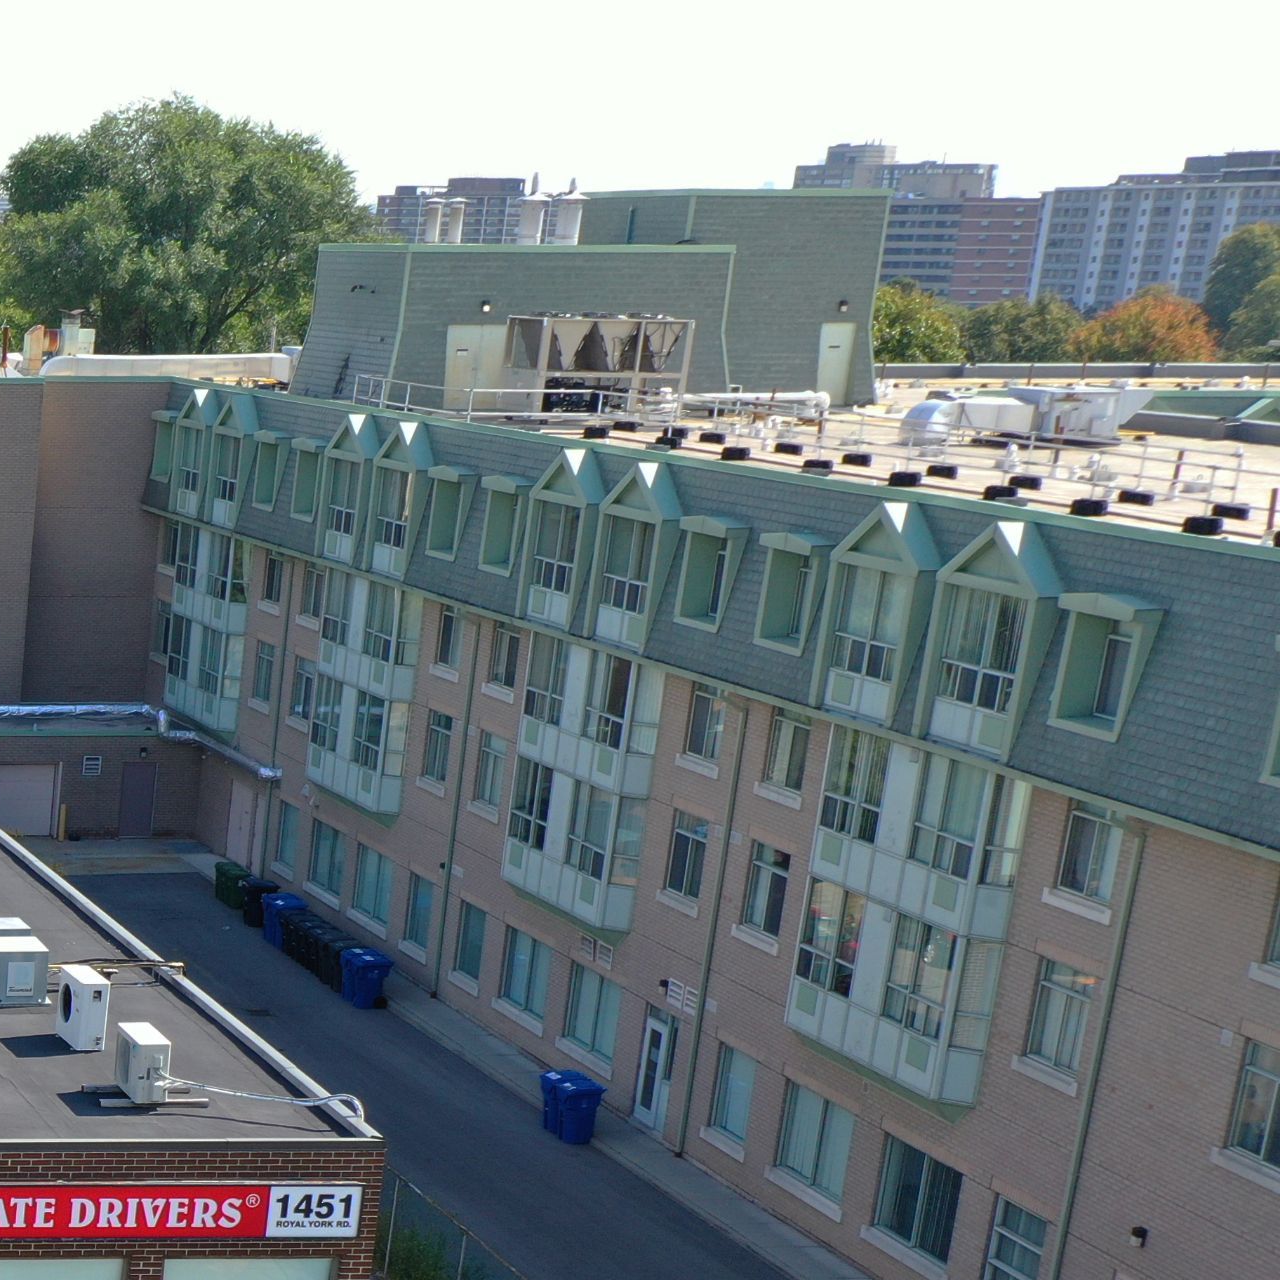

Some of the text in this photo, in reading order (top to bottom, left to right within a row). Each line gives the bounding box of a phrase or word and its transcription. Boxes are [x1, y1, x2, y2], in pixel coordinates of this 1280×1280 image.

[275, 1194, 353, 1219] 1451
[275, 1220, 352, 1228] ROYAL YORK RD.
